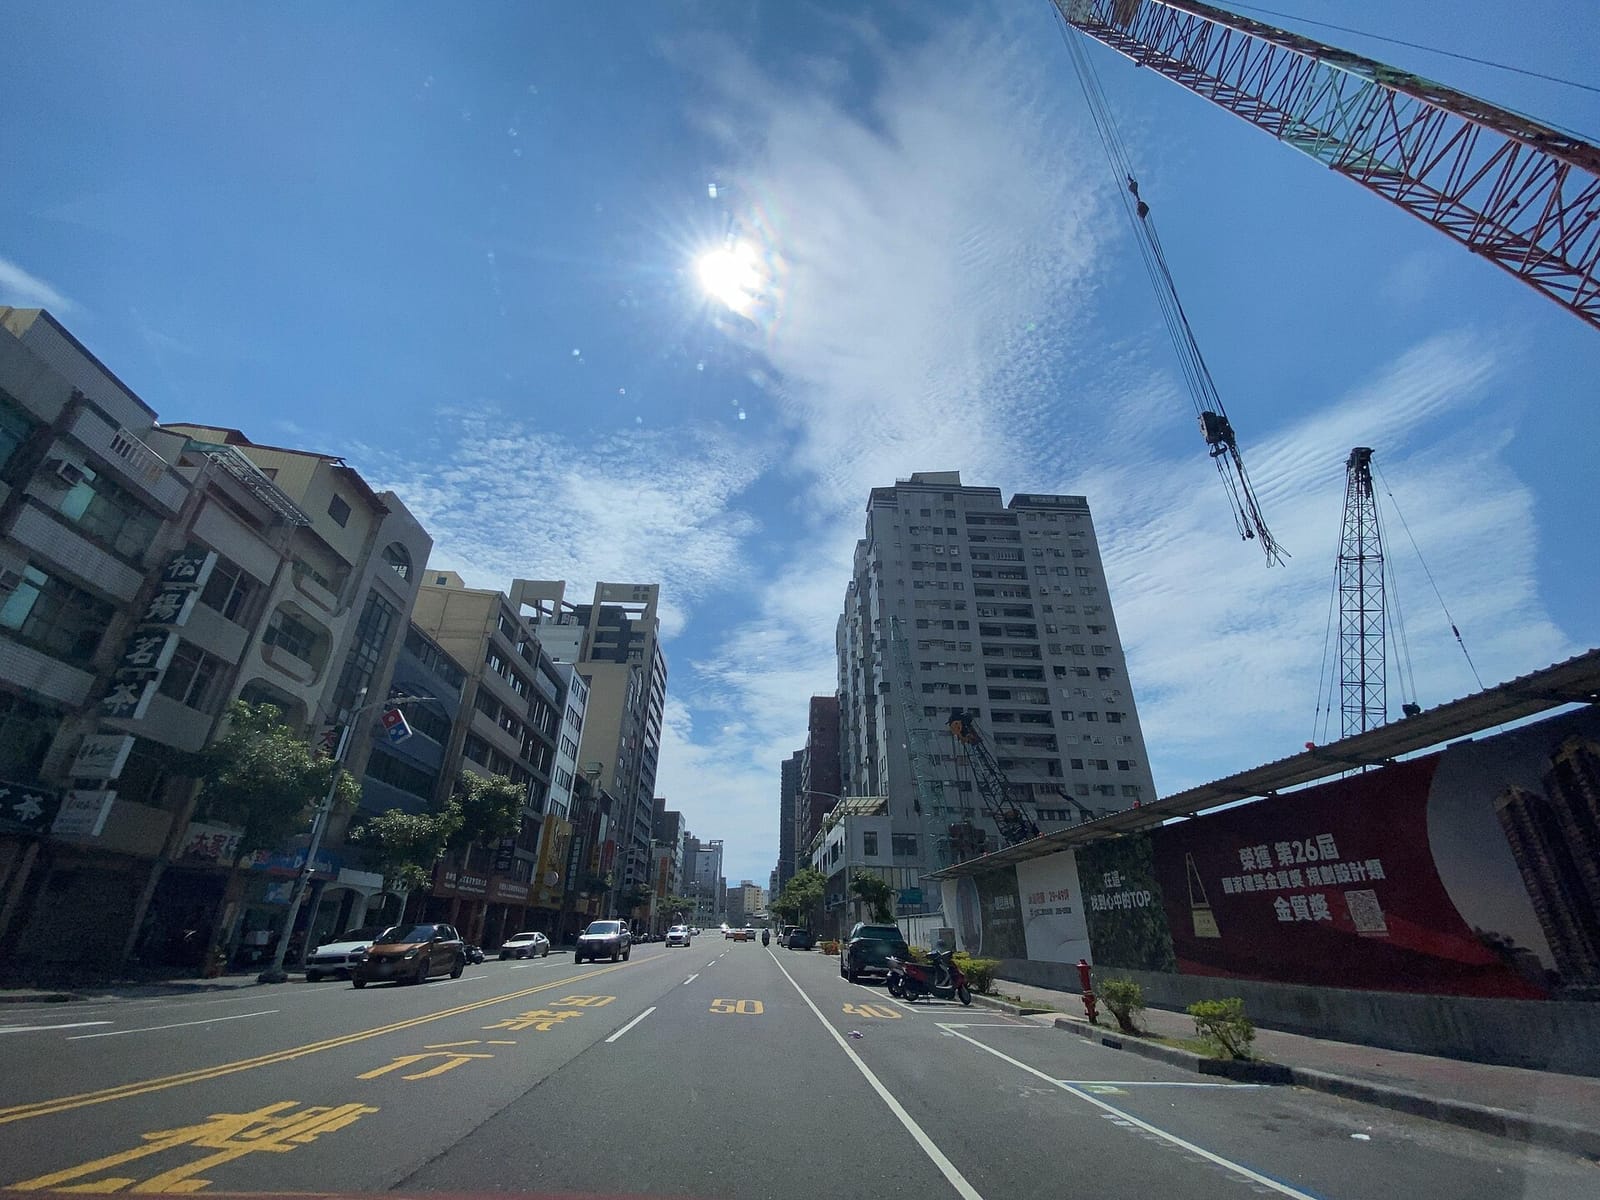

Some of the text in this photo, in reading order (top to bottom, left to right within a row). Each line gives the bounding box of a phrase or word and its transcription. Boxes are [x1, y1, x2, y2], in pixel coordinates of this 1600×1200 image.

[1238, 833, 1340, 871] 榮獲 第26屆
[1306, 858, 1386, 886] 規劃設計類
[1272, 893, 1333, 922] 金質獎
[549, 995, 617, 1008] 50
[709, 998, 764, 1016] 50
[842, 1003, 902, 1019] 40
